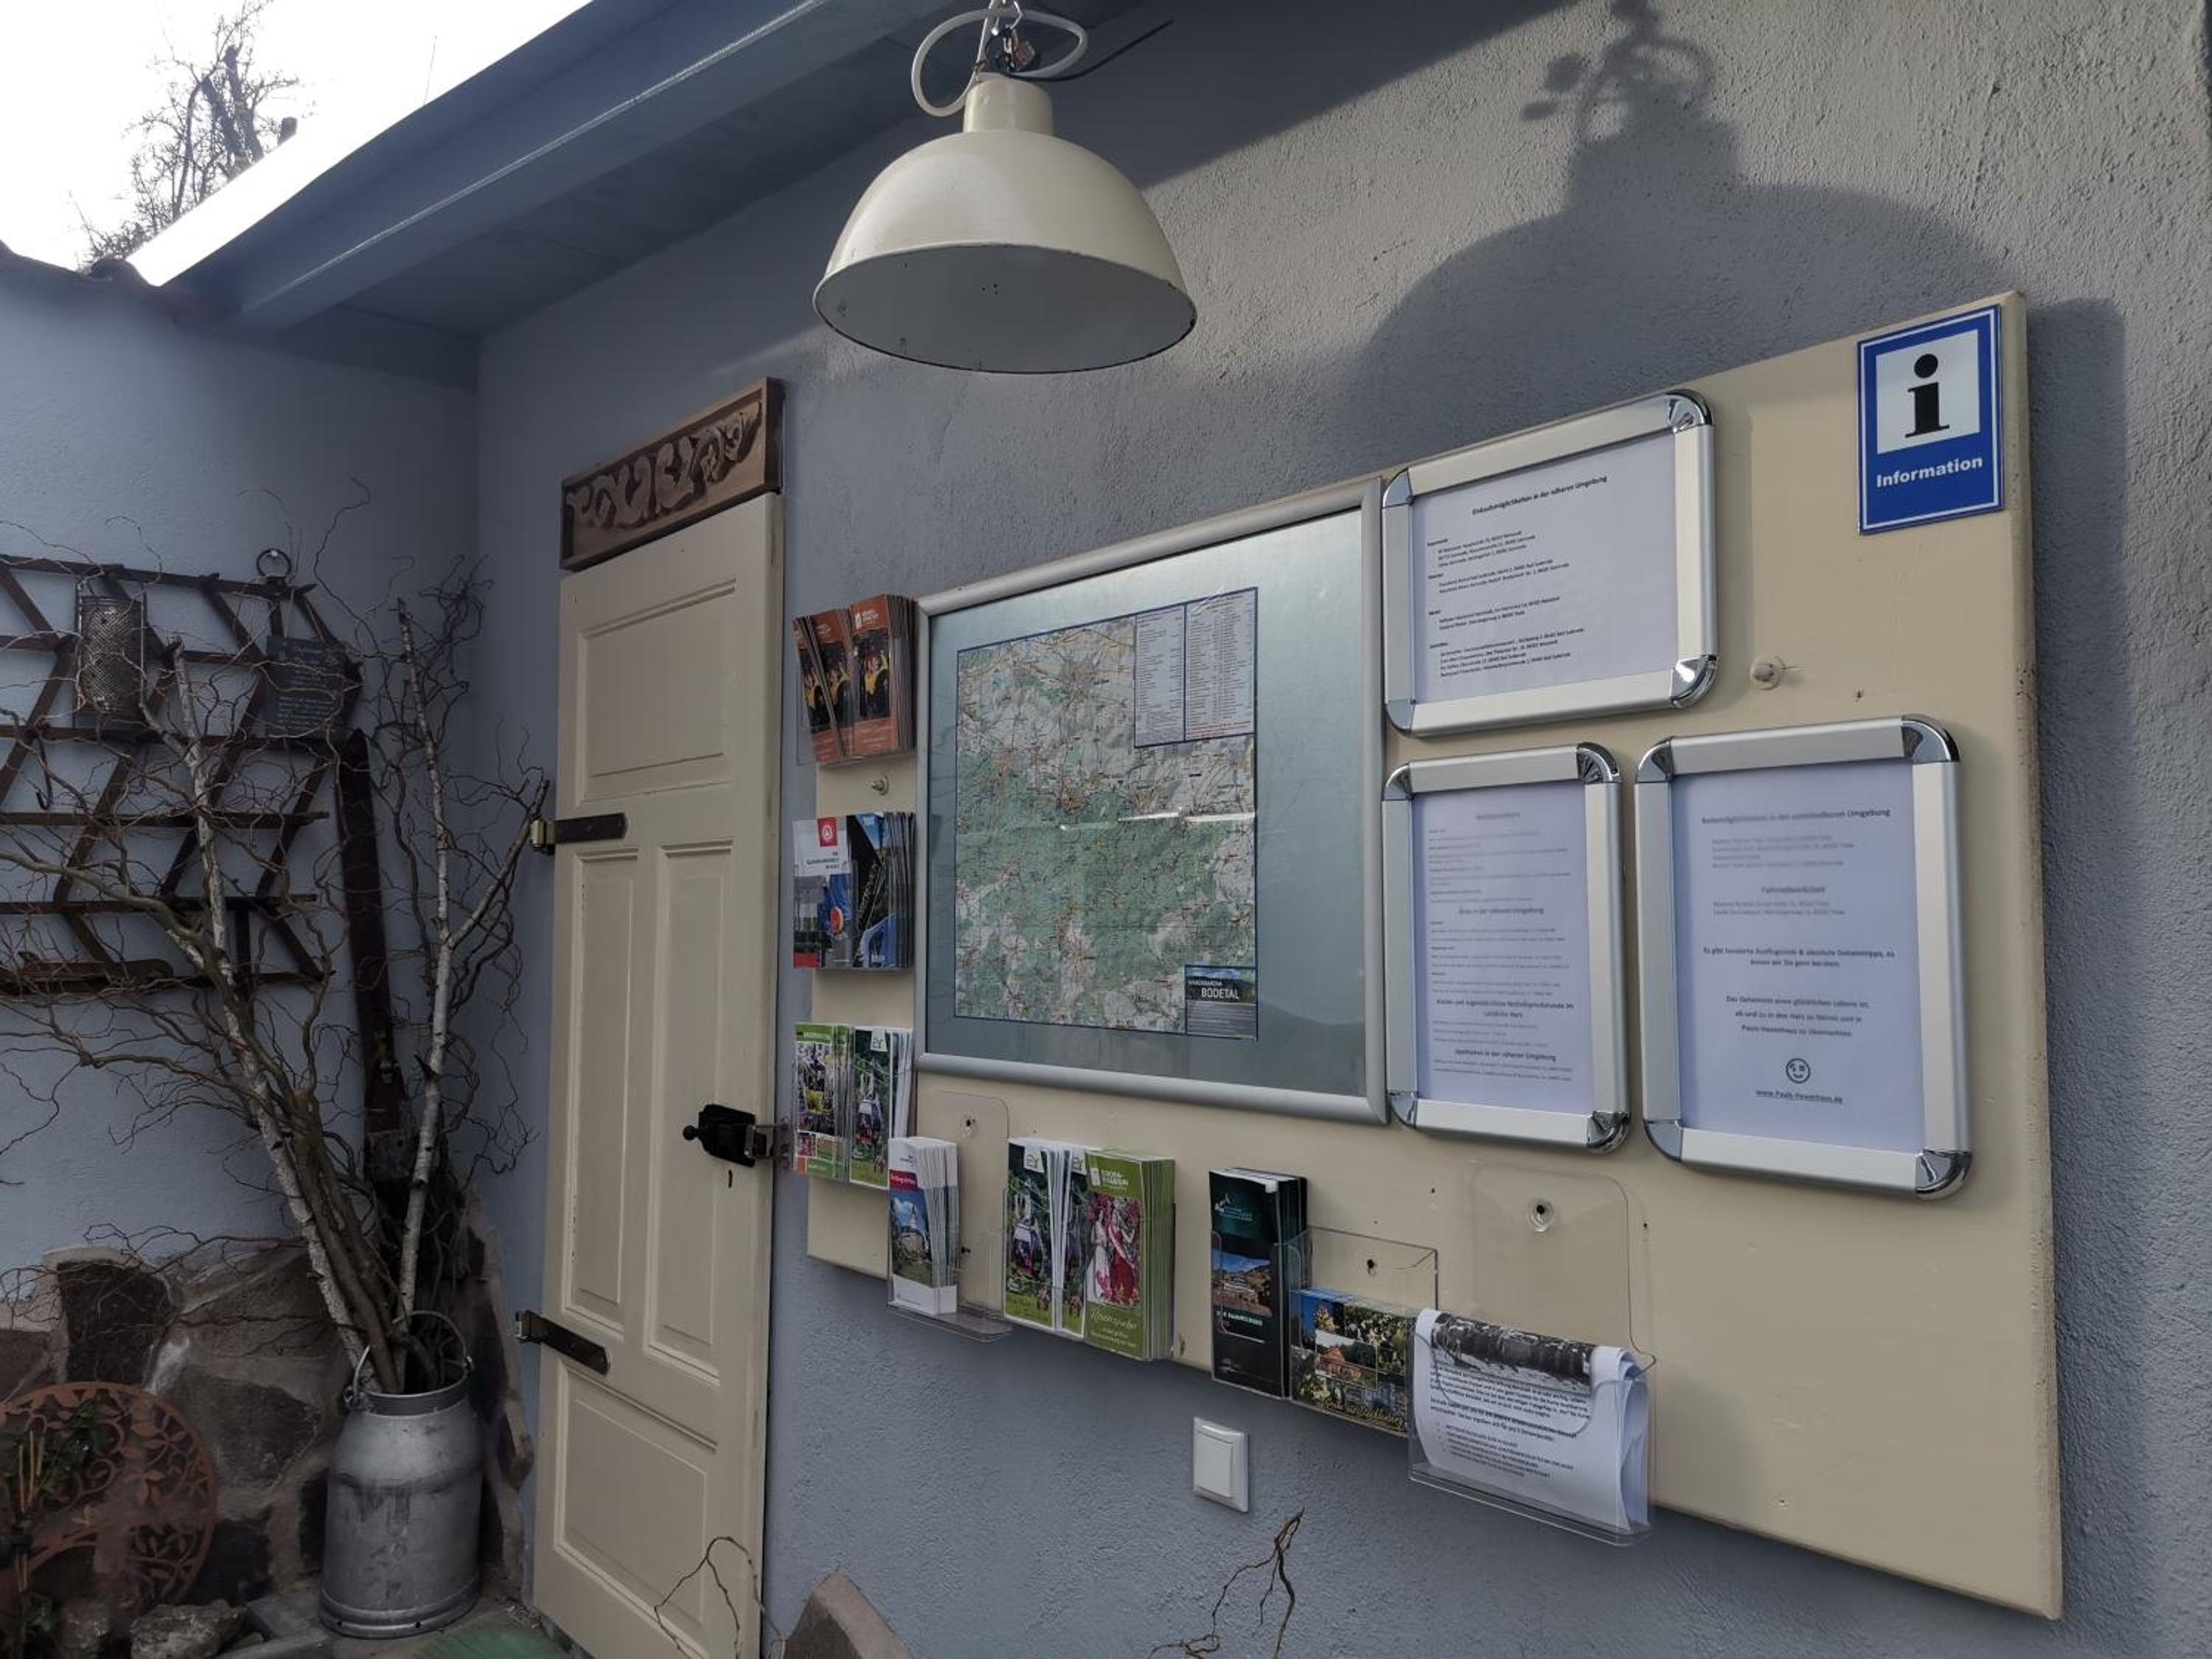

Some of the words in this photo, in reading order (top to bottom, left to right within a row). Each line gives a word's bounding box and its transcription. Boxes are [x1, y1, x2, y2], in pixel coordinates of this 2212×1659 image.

[1877, 457, 1983, 488] Information
[1847, 808, 1891, 819] Umgebung
[1201, 987, 1239, 1000] BODETAL
